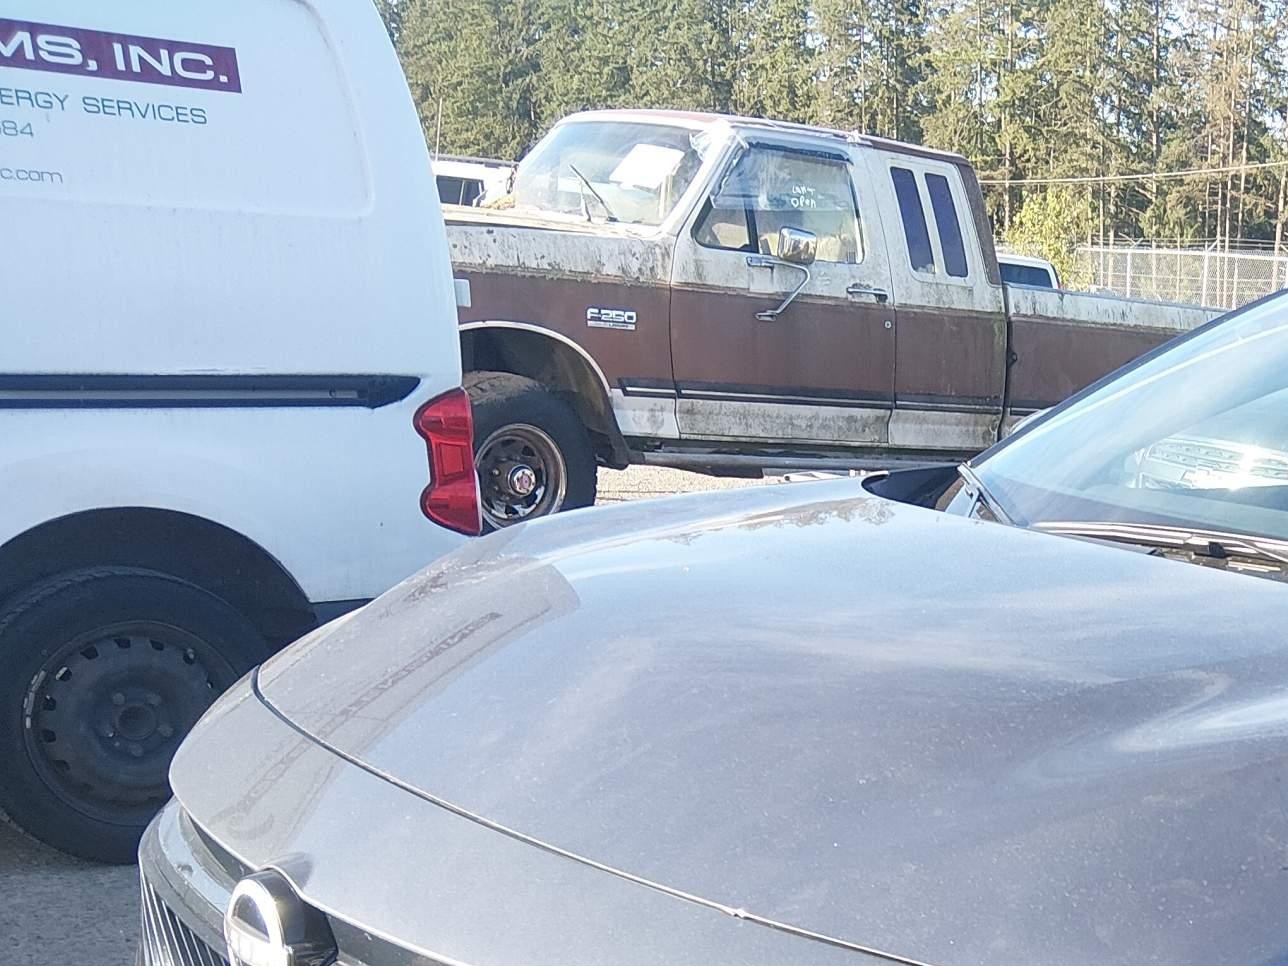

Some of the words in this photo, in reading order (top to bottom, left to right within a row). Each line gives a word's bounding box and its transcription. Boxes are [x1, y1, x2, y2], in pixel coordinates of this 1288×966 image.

[0, 31, 98, 71] MS,
[112, 42, 229, 83] INC.
[82, 95, 208, 125] SERVICES
[0, 120, 34, 137] 84
[587, 307, 637, 323] F-250
